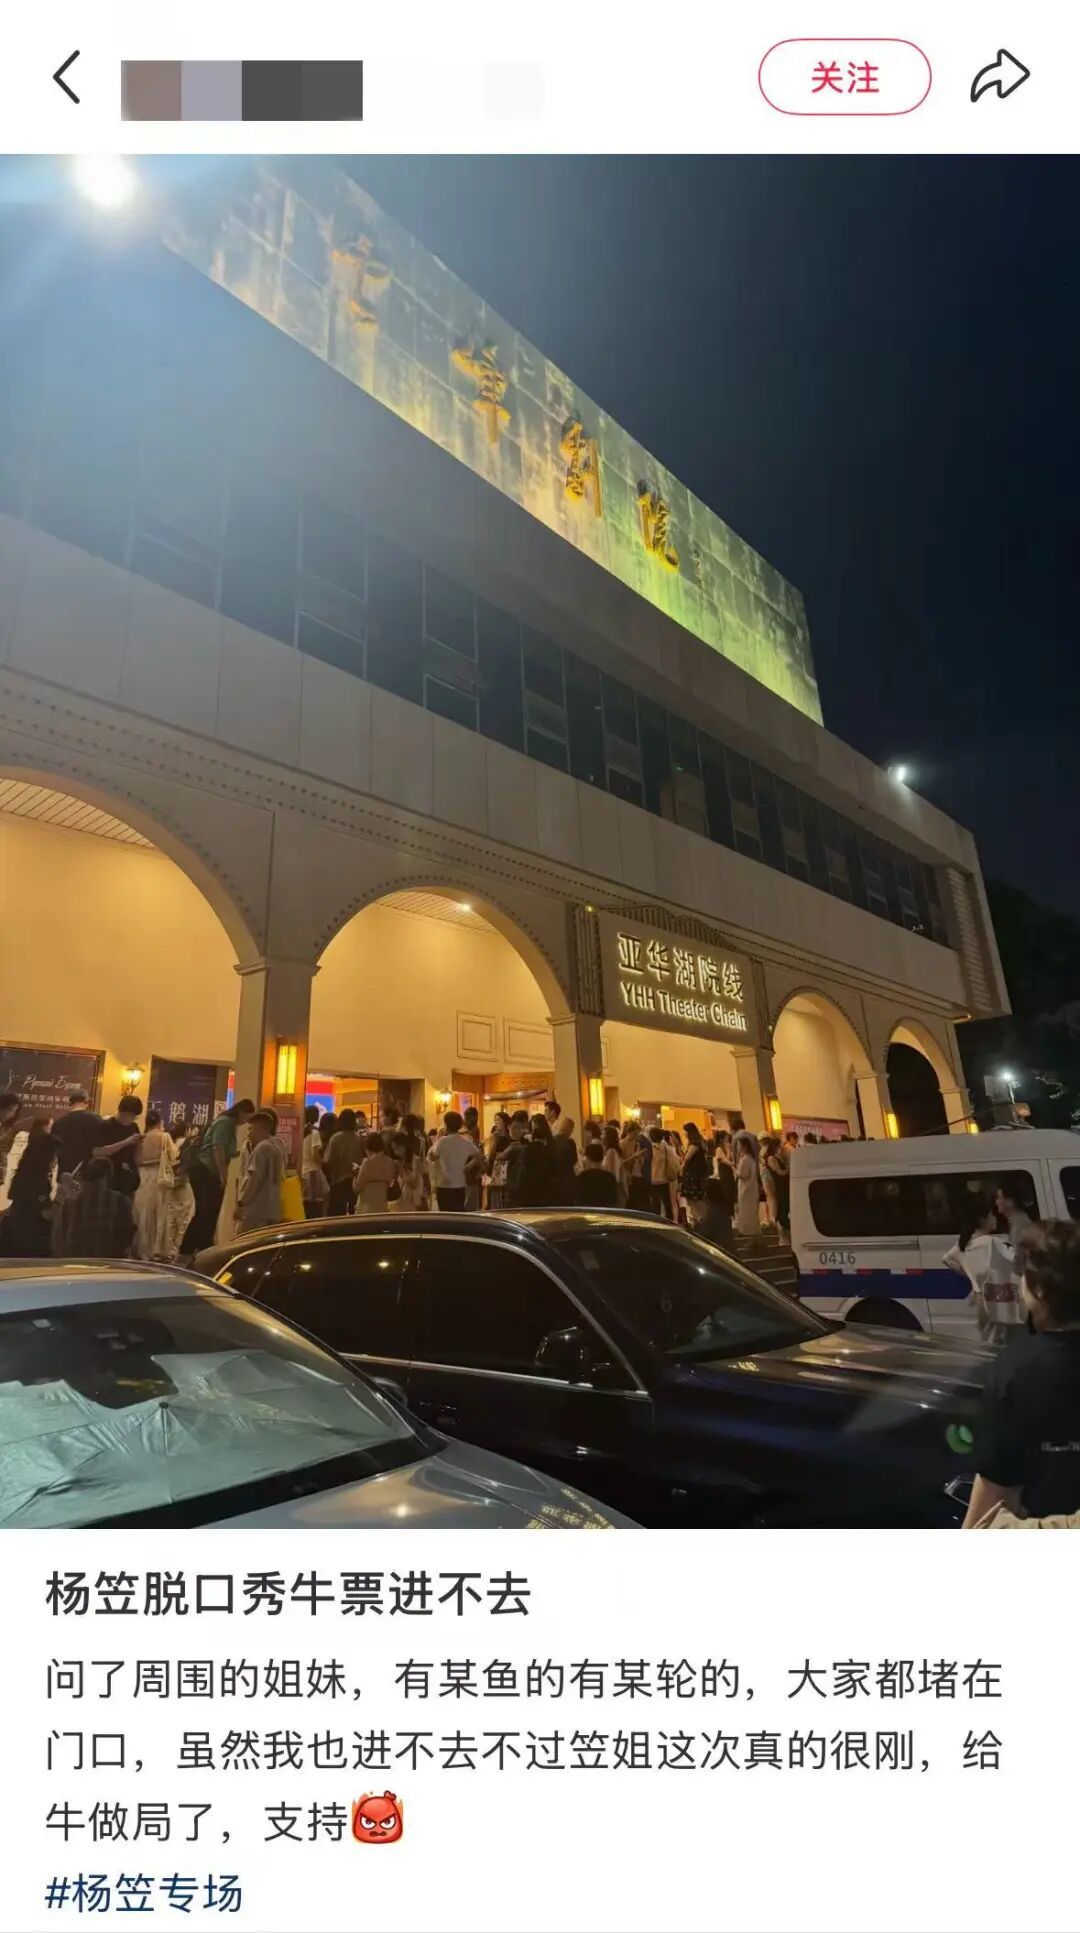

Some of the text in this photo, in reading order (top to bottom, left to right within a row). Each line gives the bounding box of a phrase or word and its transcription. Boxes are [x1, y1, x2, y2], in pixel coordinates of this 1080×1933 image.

[617, 931, 745, 1002] 亚华湖院线
[619, 980, 748, 1031] YHH Theater Chain
[818, 1250, 857, 1265] 0416
